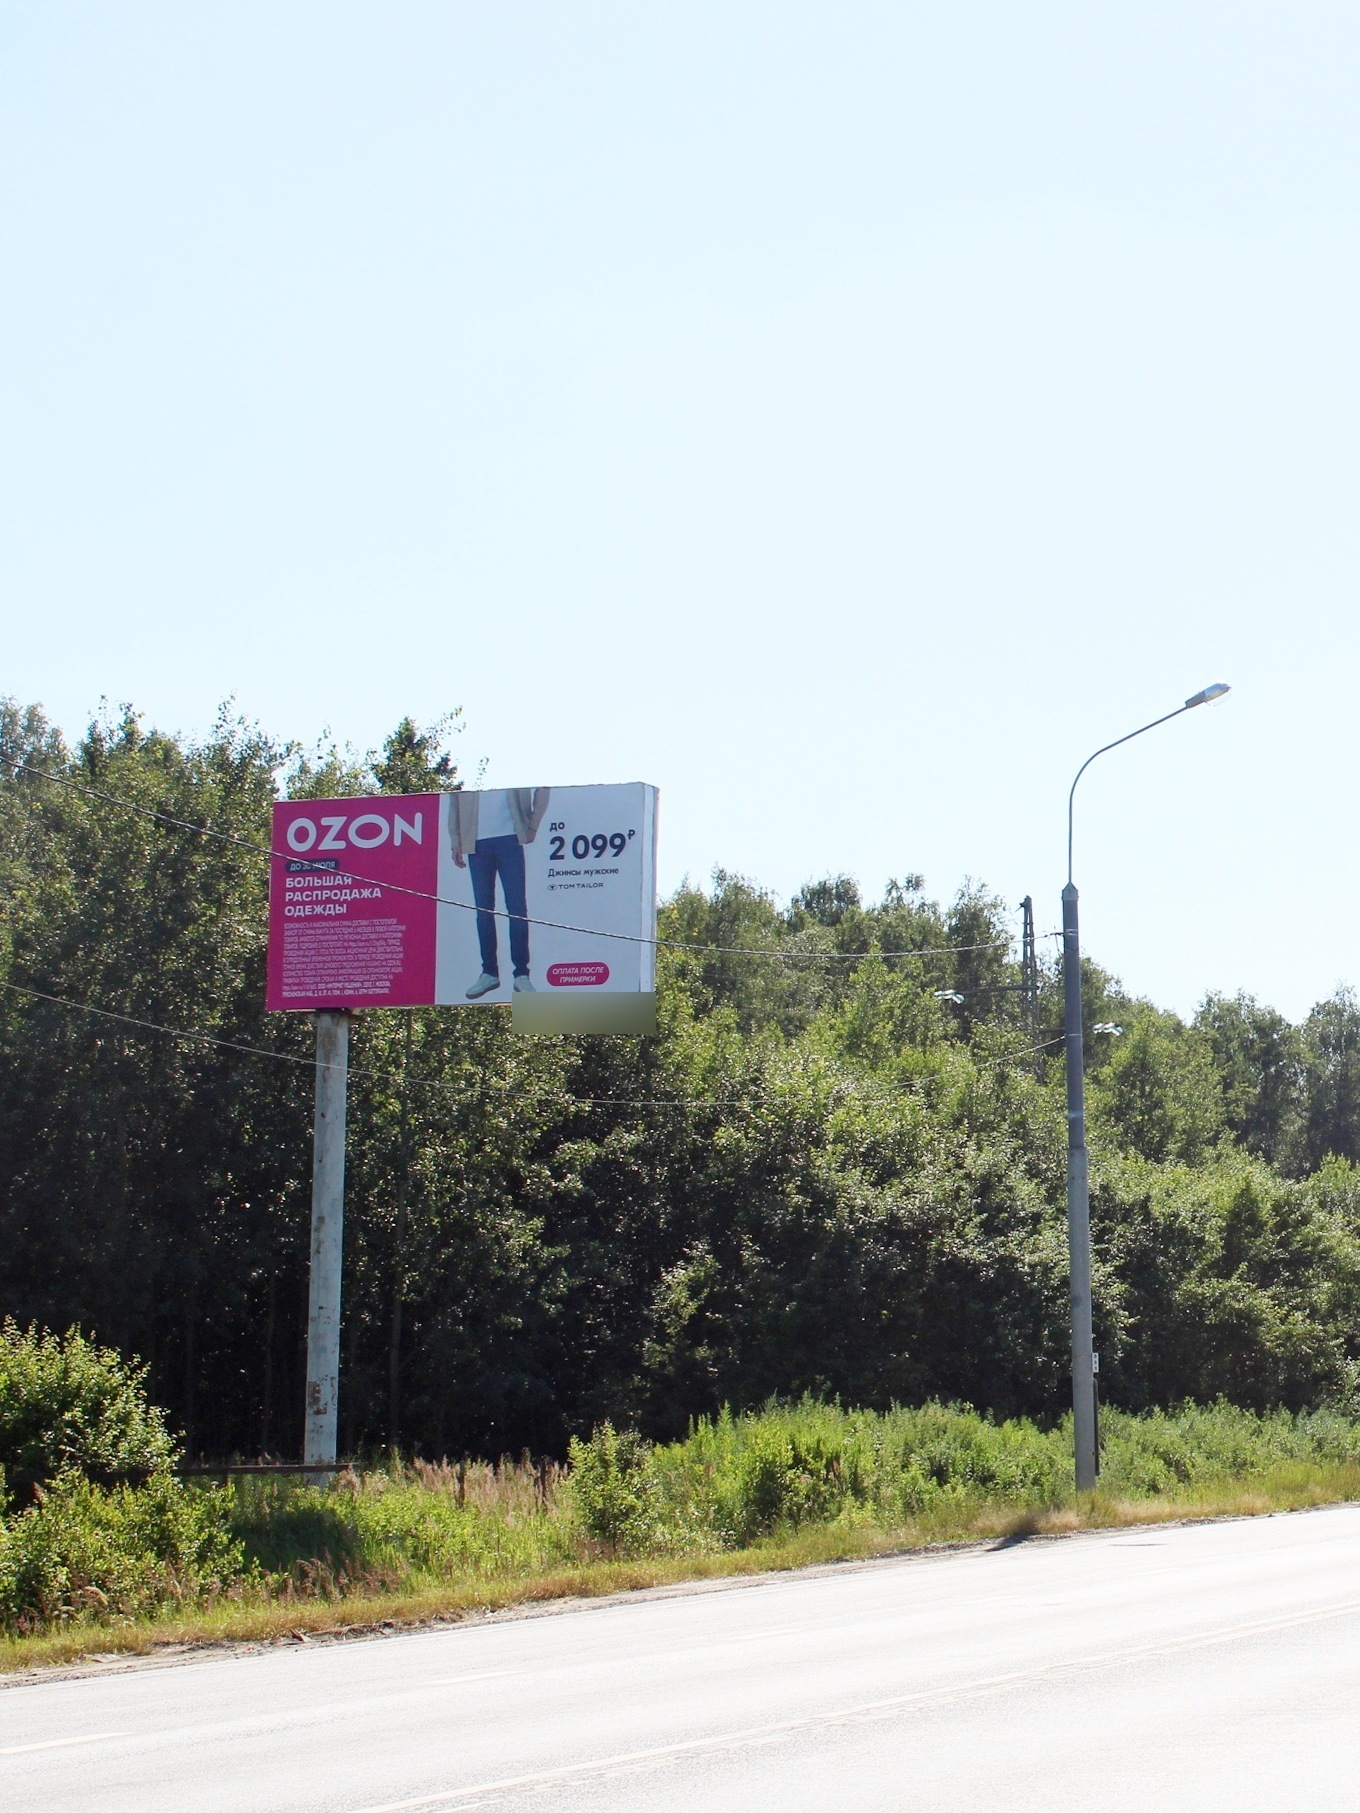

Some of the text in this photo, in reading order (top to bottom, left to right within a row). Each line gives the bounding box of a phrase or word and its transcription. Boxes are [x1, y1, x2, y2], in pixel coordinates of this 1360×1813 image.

[286, 812, 423, 852] OZON
[548, 868, 619, 878] Джинсы мужские
[285, 875, 352, 888] БОЛЬШАЯ
[285, 888, 382, 902] РАСПРОДАЖА
[284, 904, 347, 917] ОДЕЖДЫ
[552, 966, 605, 975] ОПЛАТА ПОСЛЕ
[559, 975, 596, 983] ПРИМЕРКИ
